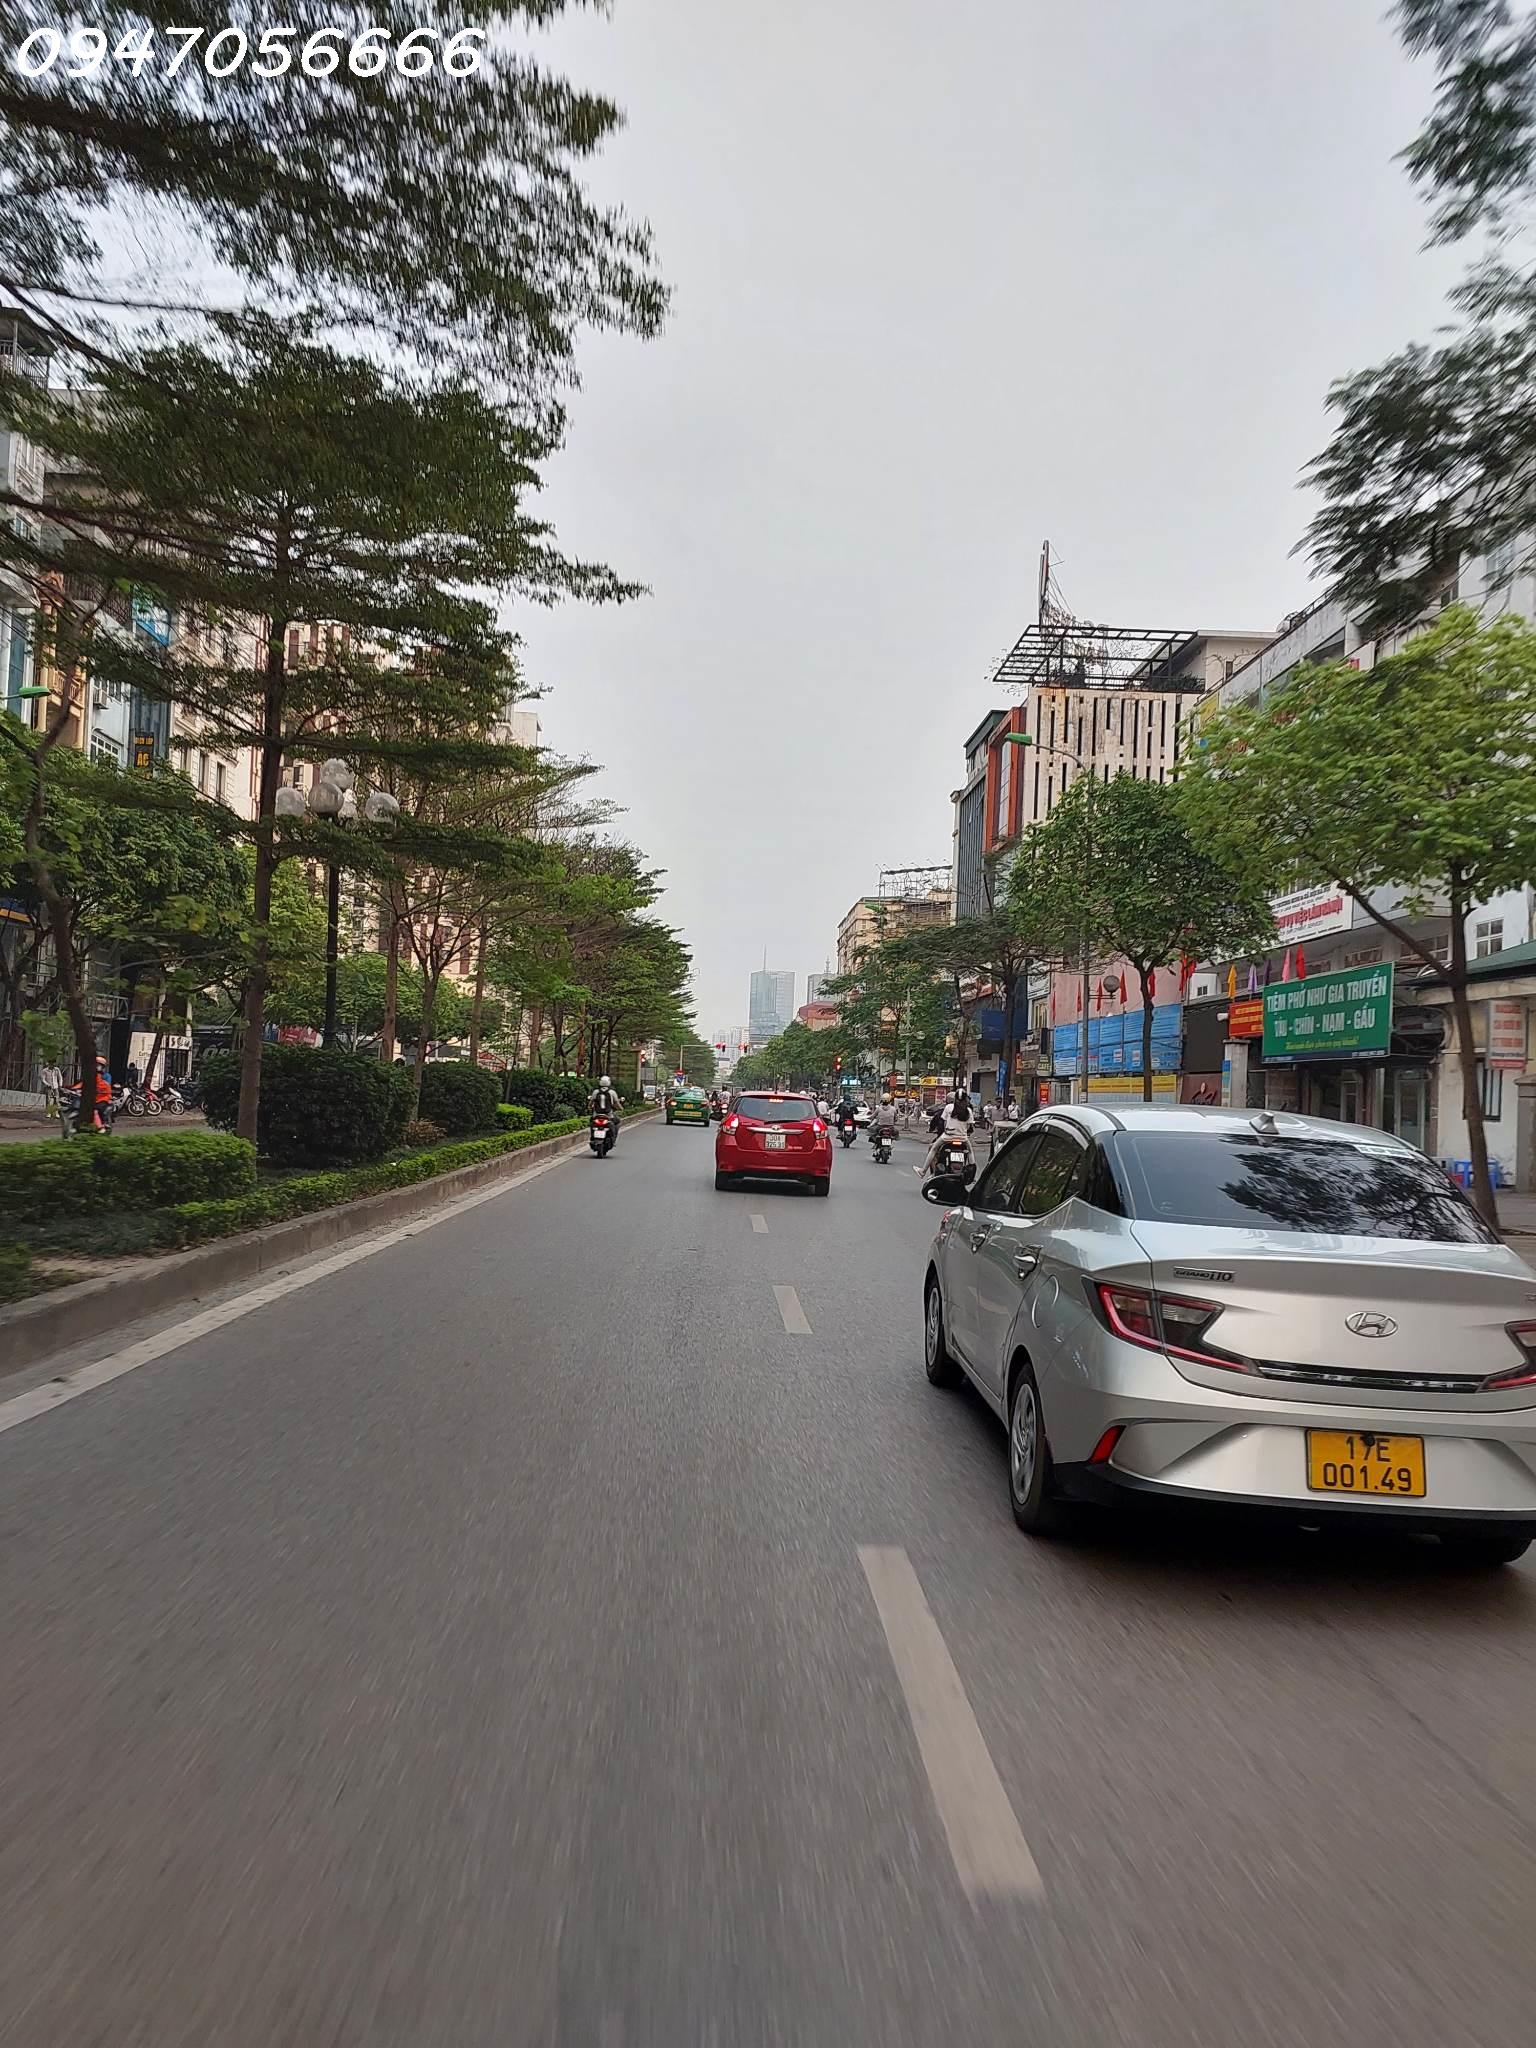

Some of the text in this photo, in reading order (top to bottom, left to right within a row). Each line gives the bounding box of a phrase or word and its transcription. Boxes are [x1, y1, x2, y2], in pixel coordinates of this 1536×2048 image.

[1266, 991, 1286, 1015] TIỆM
[1287, 983, 1307, 1010] PHỞ
[1307, 985, 1329, 1007] NHƯ
[1328, 983, 1345, 1004] GIA
[1322, 1012, 1345, 1036] NẠM
[1345, 1436, 1391, 1462] 17E
[1323, 1462, 1411, 1492] 001.49
